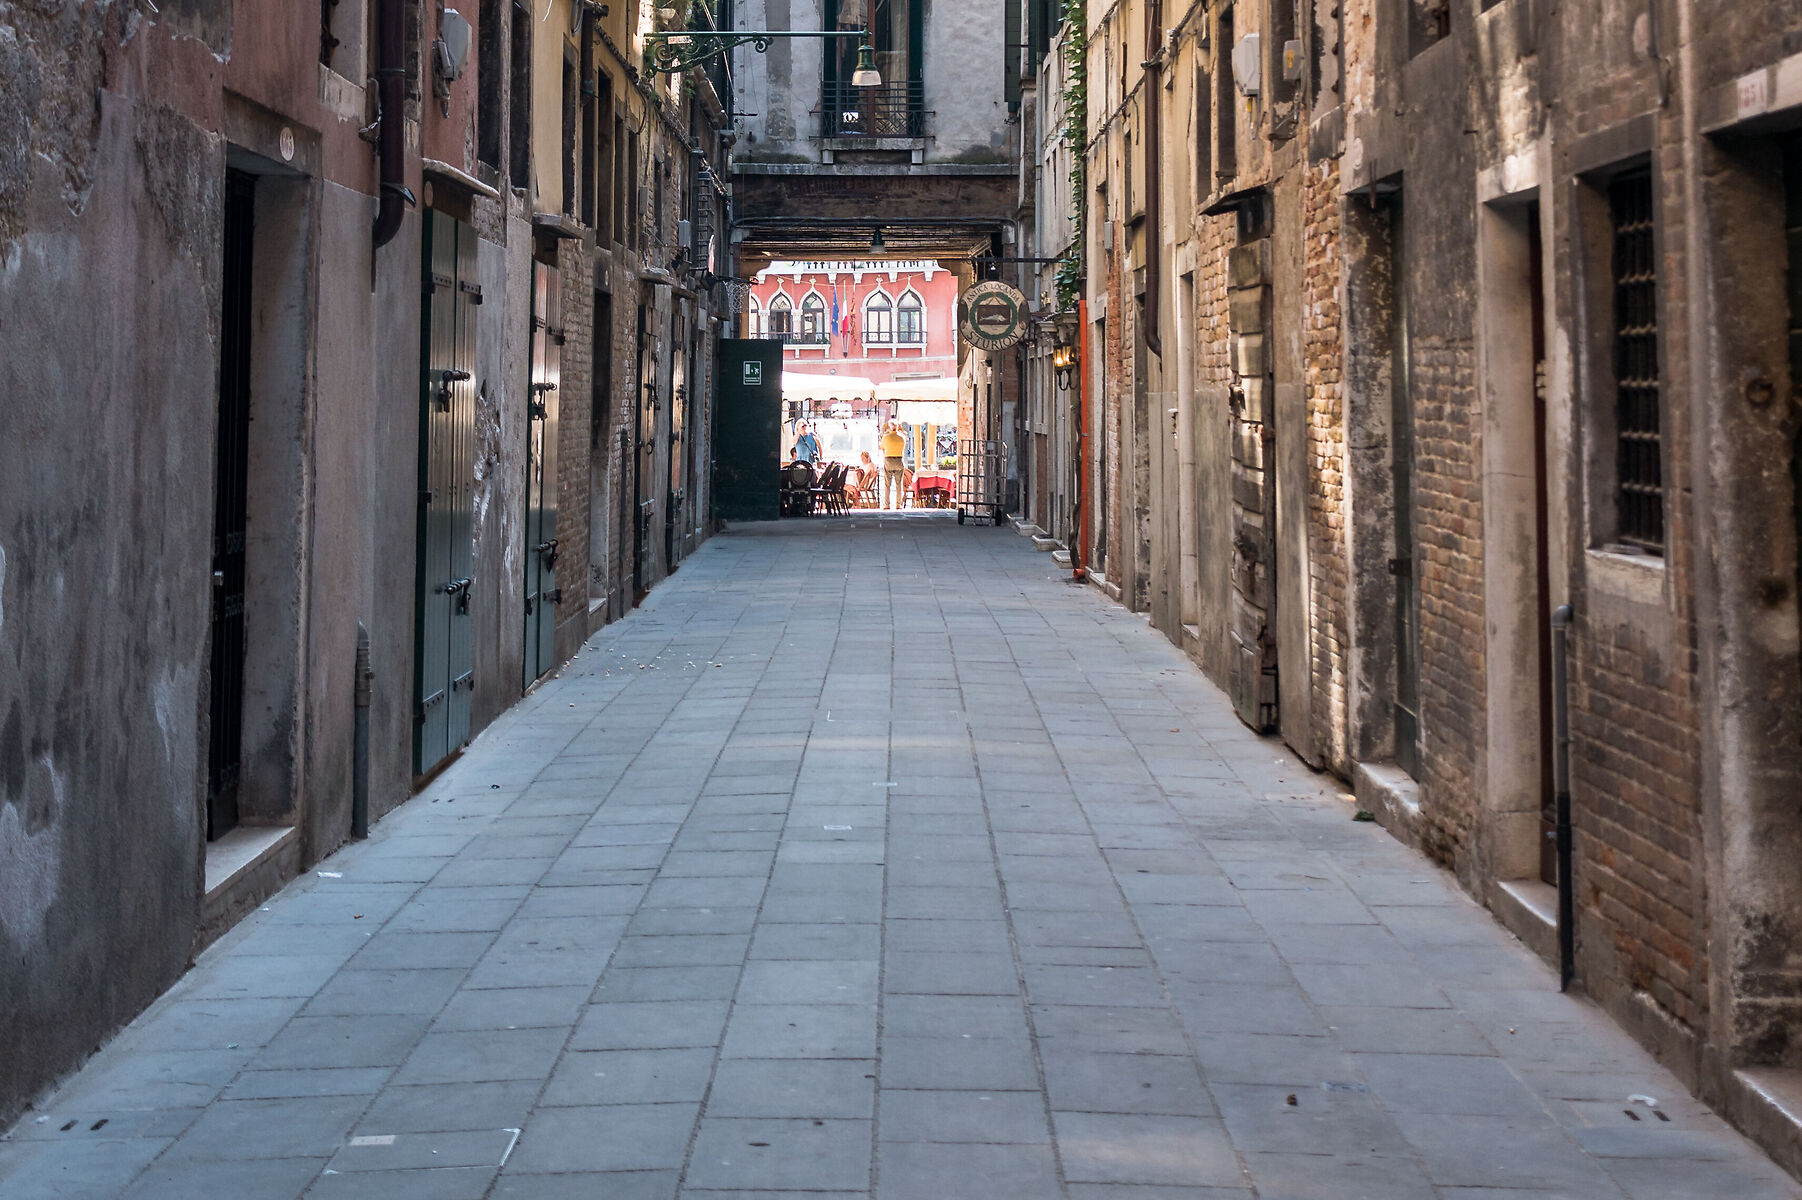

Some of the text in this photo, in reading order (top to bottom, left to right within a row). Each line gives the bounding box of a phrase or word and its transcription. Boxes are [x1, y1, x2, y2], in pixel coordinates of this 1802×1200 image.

[967, 283, 1020, 302] ANTICA LOCANDA
[967, 331, 1019, 350] STURION
